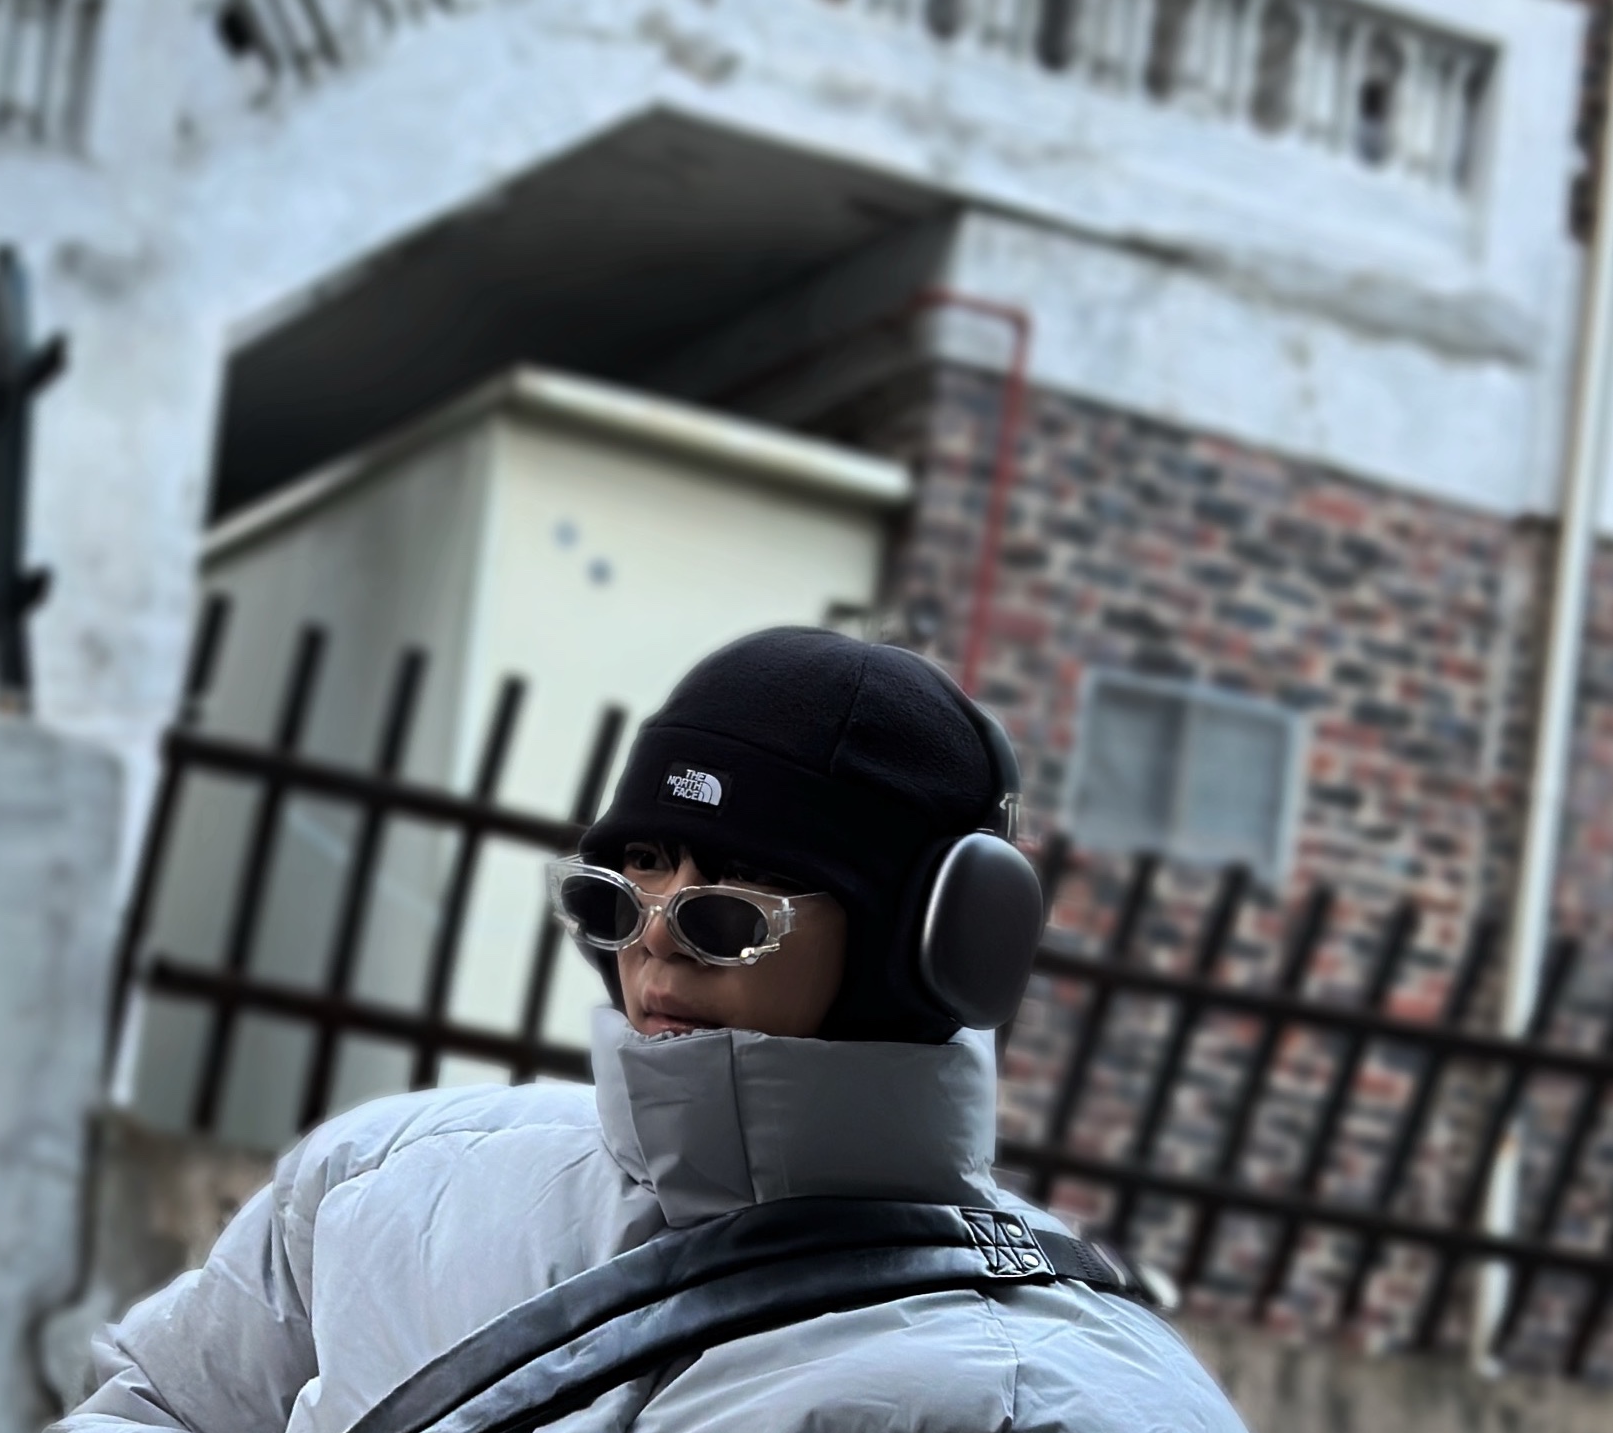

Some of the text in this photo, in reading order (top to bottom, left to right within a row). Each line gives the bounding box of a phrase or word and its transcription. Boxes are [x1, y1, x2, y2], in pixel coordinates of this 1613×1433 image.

[686, 768, 707, 782] THE
[666, 775, 704, 791] NORTH
[672, 786, 700, 801] FACE
